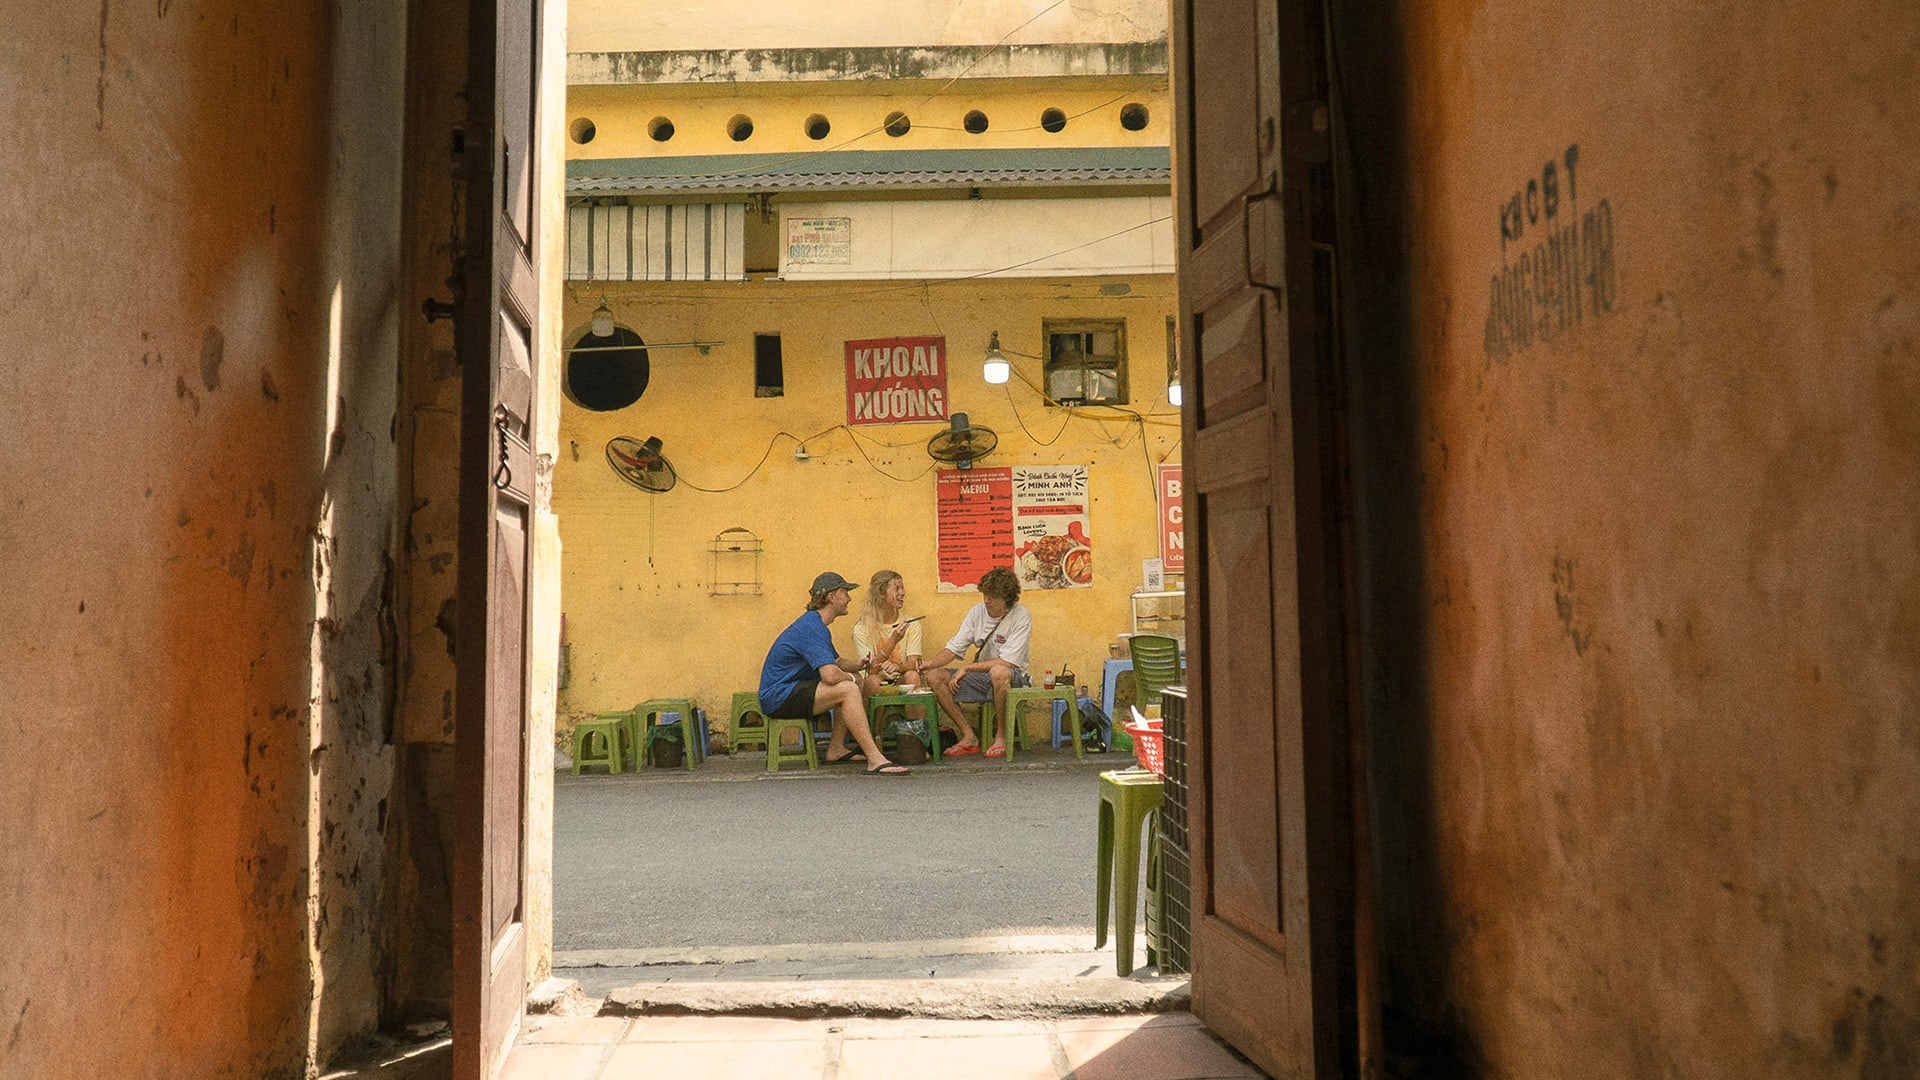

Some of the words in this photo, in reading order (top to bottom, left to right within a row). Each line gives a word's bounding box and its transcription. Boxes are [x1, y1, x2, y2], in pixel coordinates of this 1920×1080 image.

[854, 345, 938, 379] KHOAI
[854, 381, 943, 420] NƯỚNG
[960, 483, 989, 494] MENU
[1167, 480, 1182, 497] B
[1168, 505, 1183, 524] C
